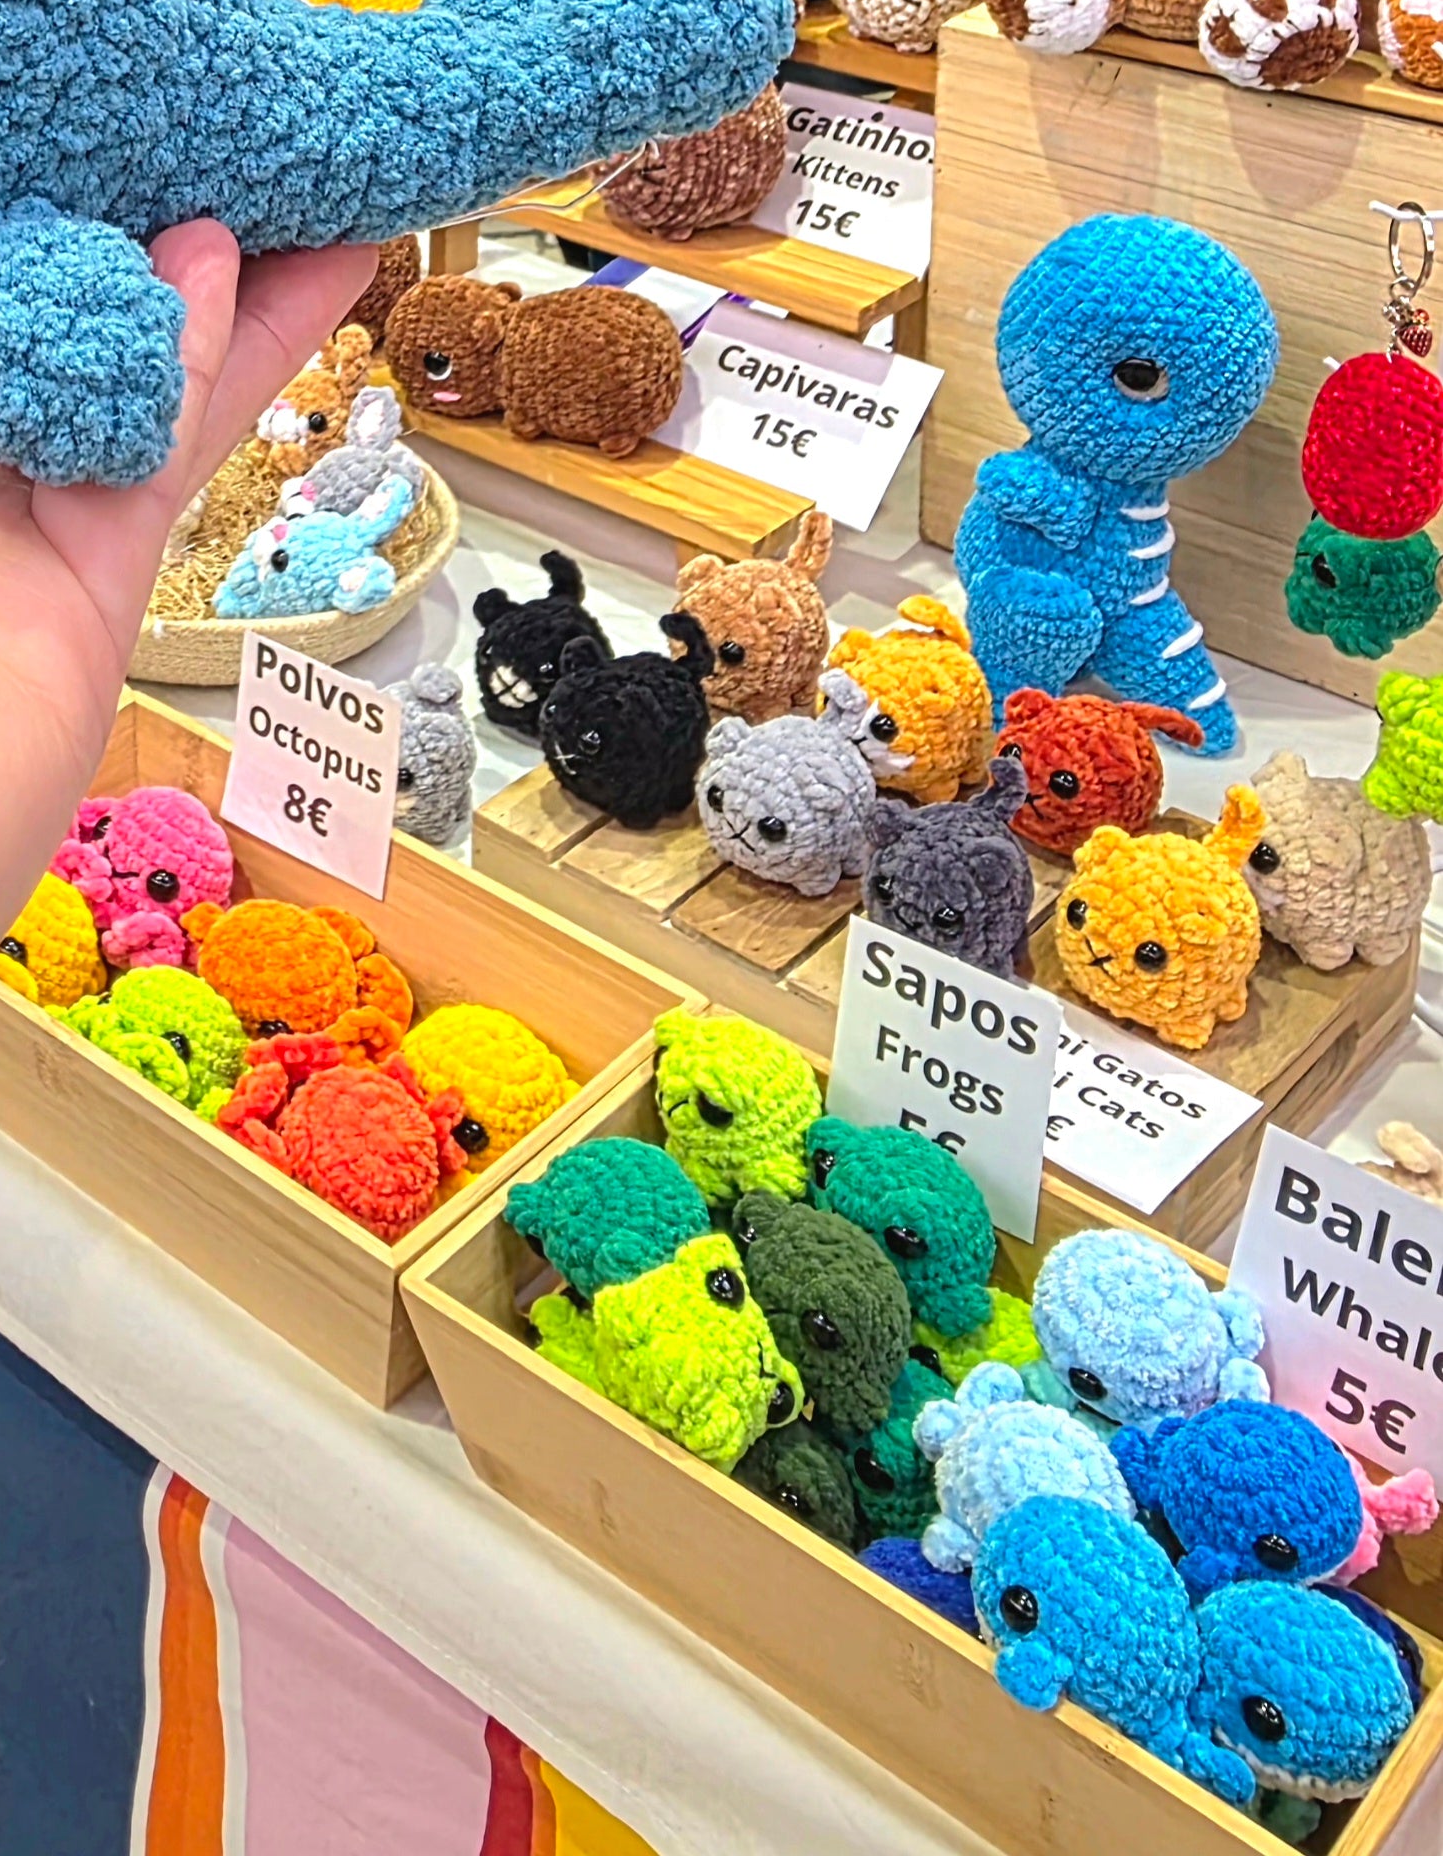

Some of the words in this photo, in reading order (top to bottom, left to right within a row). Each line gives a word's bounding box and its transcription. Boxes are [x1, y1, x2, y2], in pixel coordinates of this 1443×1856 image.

[786, 107, 934, 164] Gatinho
[791, 154, 900, 198] Kittens
[796, 199, 861, 238] 15€
[718, 345, 899, 429] Capivaras
[752, 413, 817, 458] 15€
[257, 642, 384, 734] Polvos
[249, 706, 382, 794] Octopus
[283, 783, 332, 837] 8€
[862, 941, 1039, 1055] Sapos
[876, 1024, 1004, 1115] Frogs
[1093, 1053, 1207, 1119] Gatos
[1078, 1086, 1165, 1138] Cats
[1275, 1166, 1443, 1296] Bale
[1325, 1368, 1416, 1455] 5€
